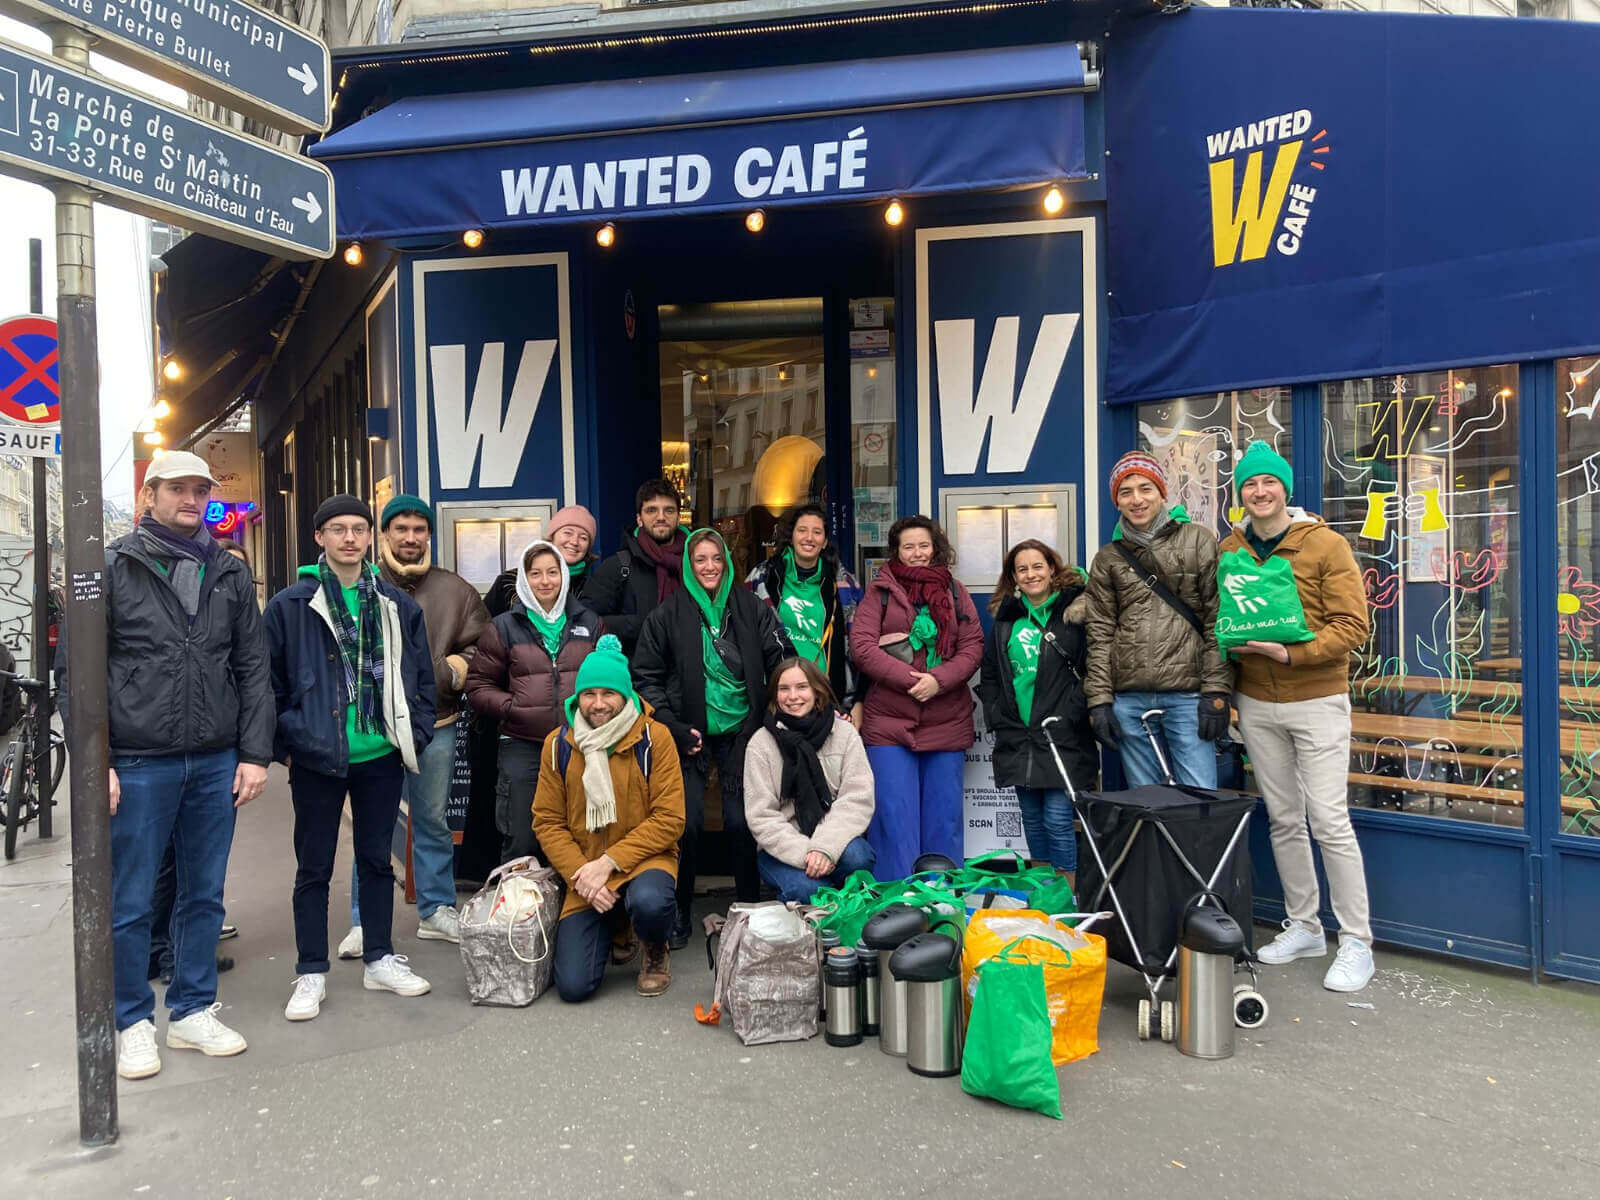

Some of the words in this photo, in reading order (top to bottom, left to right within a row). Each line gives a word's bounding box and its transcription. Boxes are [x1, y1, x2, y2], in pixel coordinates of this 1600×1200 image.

[60, 0, 93, 14] ue
[103, 3, 165, 47] Pierre
[174, 36, 232, 77] Bullet
[177, 0, 283, 52] unicipal
[28, 68, 133, 128] Marché
[146, 116, 175, 143] de
[1206, 109, 1312, 158] WANTED
[28, 130, 103, 174] 31-33,
[109, 158, 144, 185] Rue
[154, 173, 175, 195] du
[183, 181, 247, 220] Château
[255, 206, 294, 236] d'Eau
[29, 98, 60, 132] La
[74, 115, 146, 160] Porte
[159, 144, 182, 170] St
[186, 153, 262, 201] Martin
[501, 153, 711, 216] WANTED
[734, 126, 868, 199] CAFÉ
[1209, 139, 1303, 268] W
[1277, 183, 1317, 256] CAFÉ
[430, 338, 558, 491] W
[934, 312, 1080, 475] W
[0, 432, 51, 450] SAUF
[1216, 616, 1255, 634] Dans
[1256, 619, 1279, 628] ma
[1279, 615, 1299, 625] rue
[968, 819, 993, 828] SCAN
